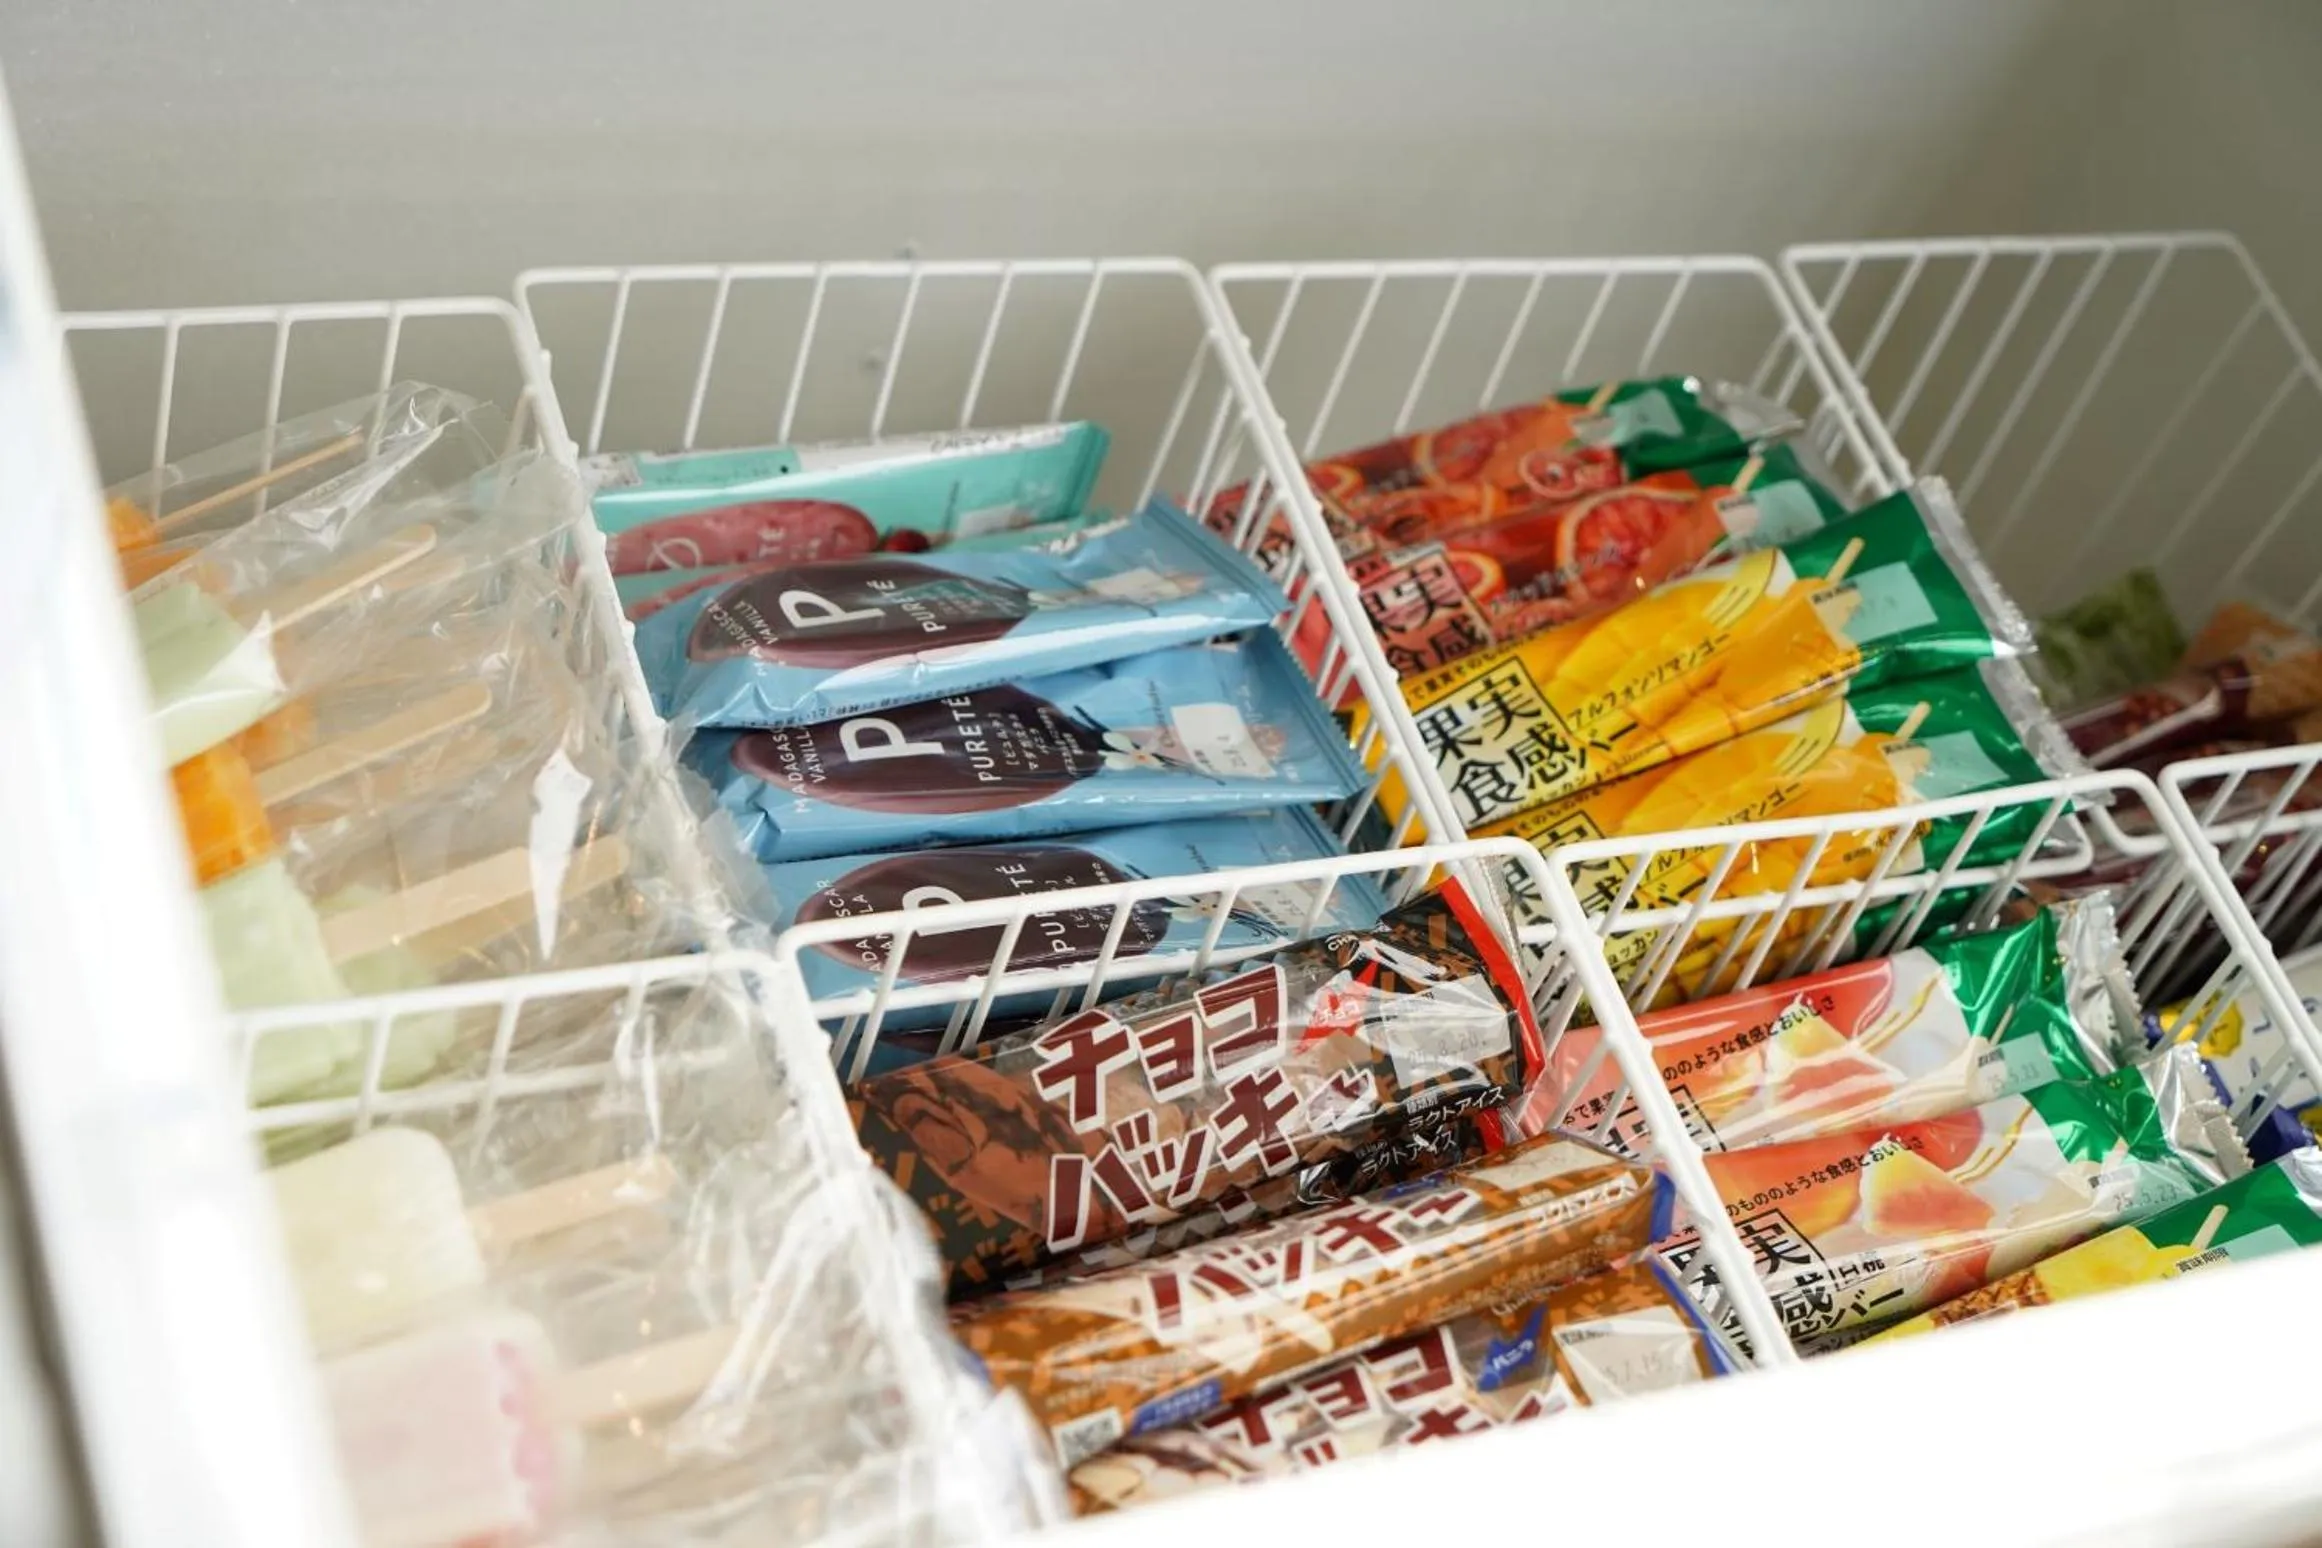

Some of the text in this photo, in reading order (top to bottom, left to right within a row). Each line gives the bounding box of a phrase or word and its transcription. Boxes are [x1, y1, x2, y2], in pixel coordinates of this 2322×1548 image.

[778, 589, 886, 628] P
[839, 717, 946, 763] P
[941, 695, 1002, 782] PURETÉ
[1415, 670, 1542, 768] 果実
[1451, 721, 1639, 826] 食感バー
[1032, 962, 1288, 1135] チョコ
[1046, 1064, 1378, 1249] バッキー
[1408, 1086, 1505, 1129] ラクトアイス
[1148, 1189, 1480, 1340] バッキー
